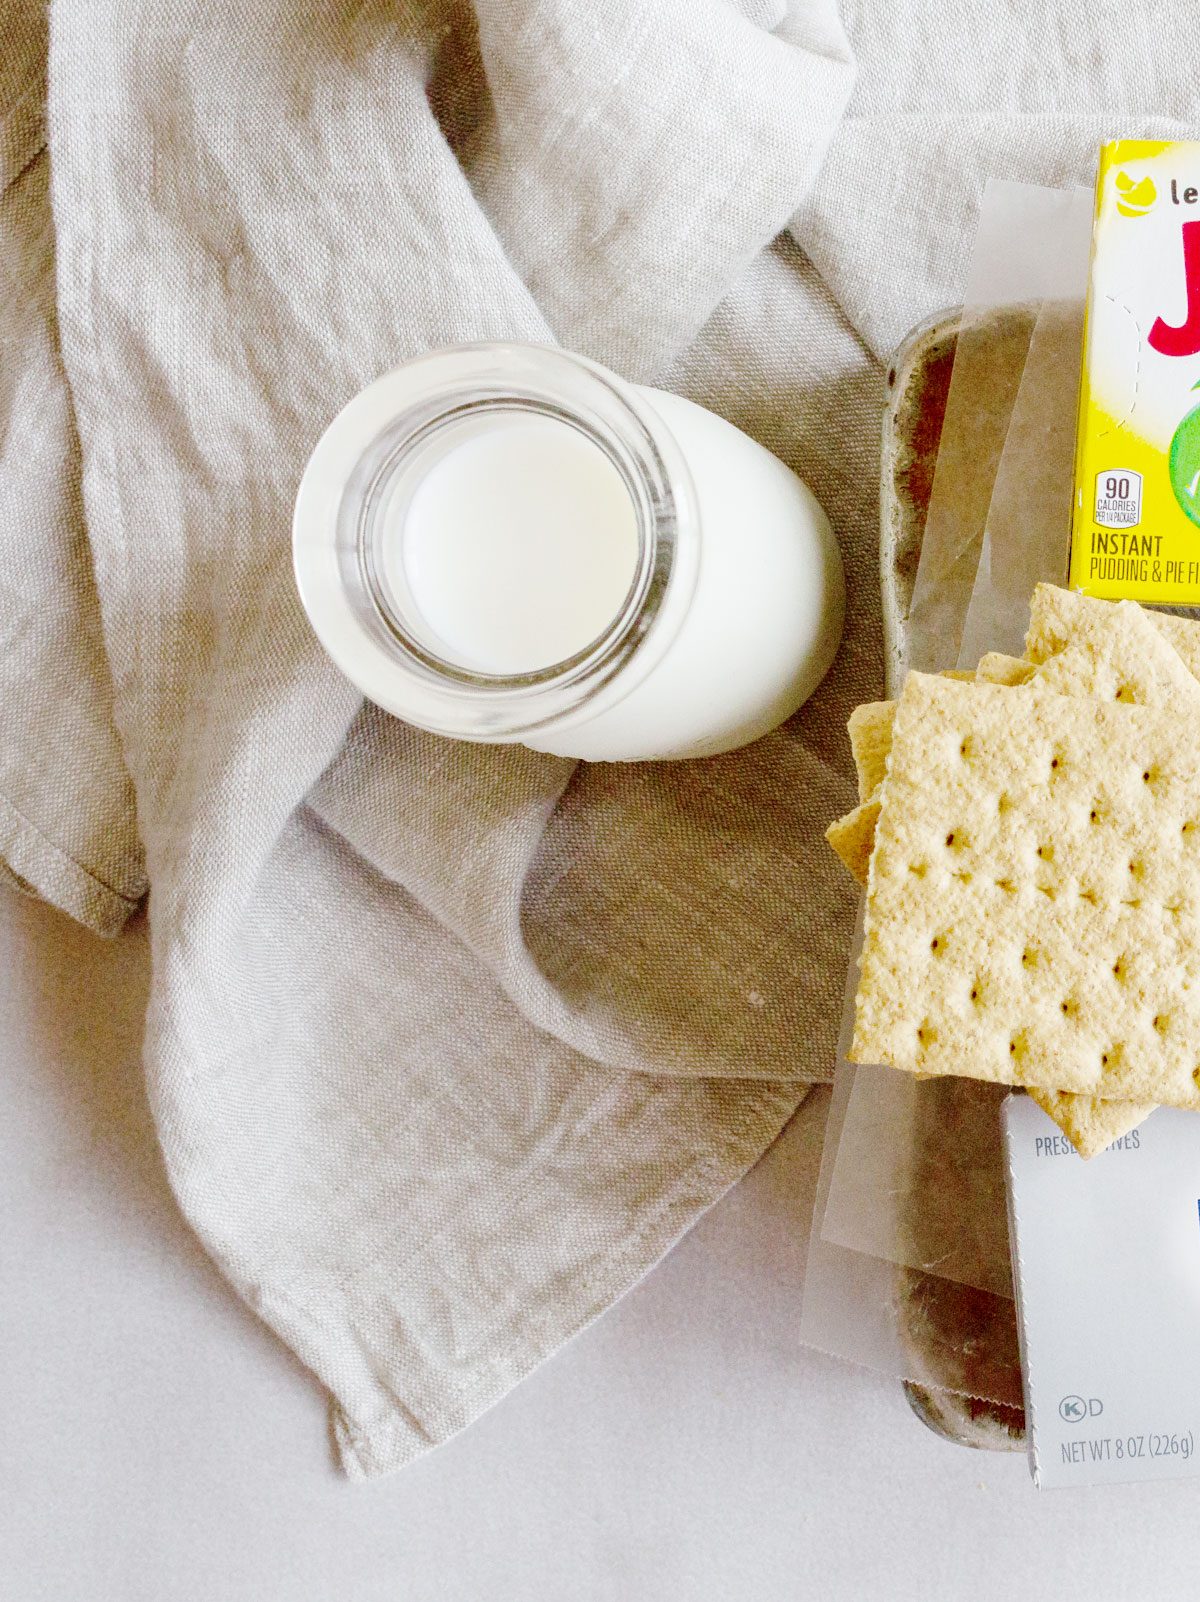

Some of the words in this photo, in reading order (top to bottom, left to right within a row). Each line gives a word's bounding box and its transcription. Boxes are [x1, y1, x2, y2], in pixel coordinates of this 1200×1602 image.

[1106, 477, 1130, 499] 90
[1096, 510, 1105, 522] PER
[1114, 511, 1136, 523] PACKAGE
[1097, 499, 1136, 512] CALORIES
[1091, 532, 1163, 557] INSTANT
[1090, 557, 1148, 582] PUDDING
[1152, 561, 1162, 582] &
[1166, 561, 1185, 583] PIE
[1061, 1441, 1086, 1464] NET
[1089, 1439, 1111, 1461] WT
[1115, 1438, 1123, 1459] 8
[1127, 1436, 1145, 1458] OZ
[1149, 1429, 1194, 1459] (226g)
